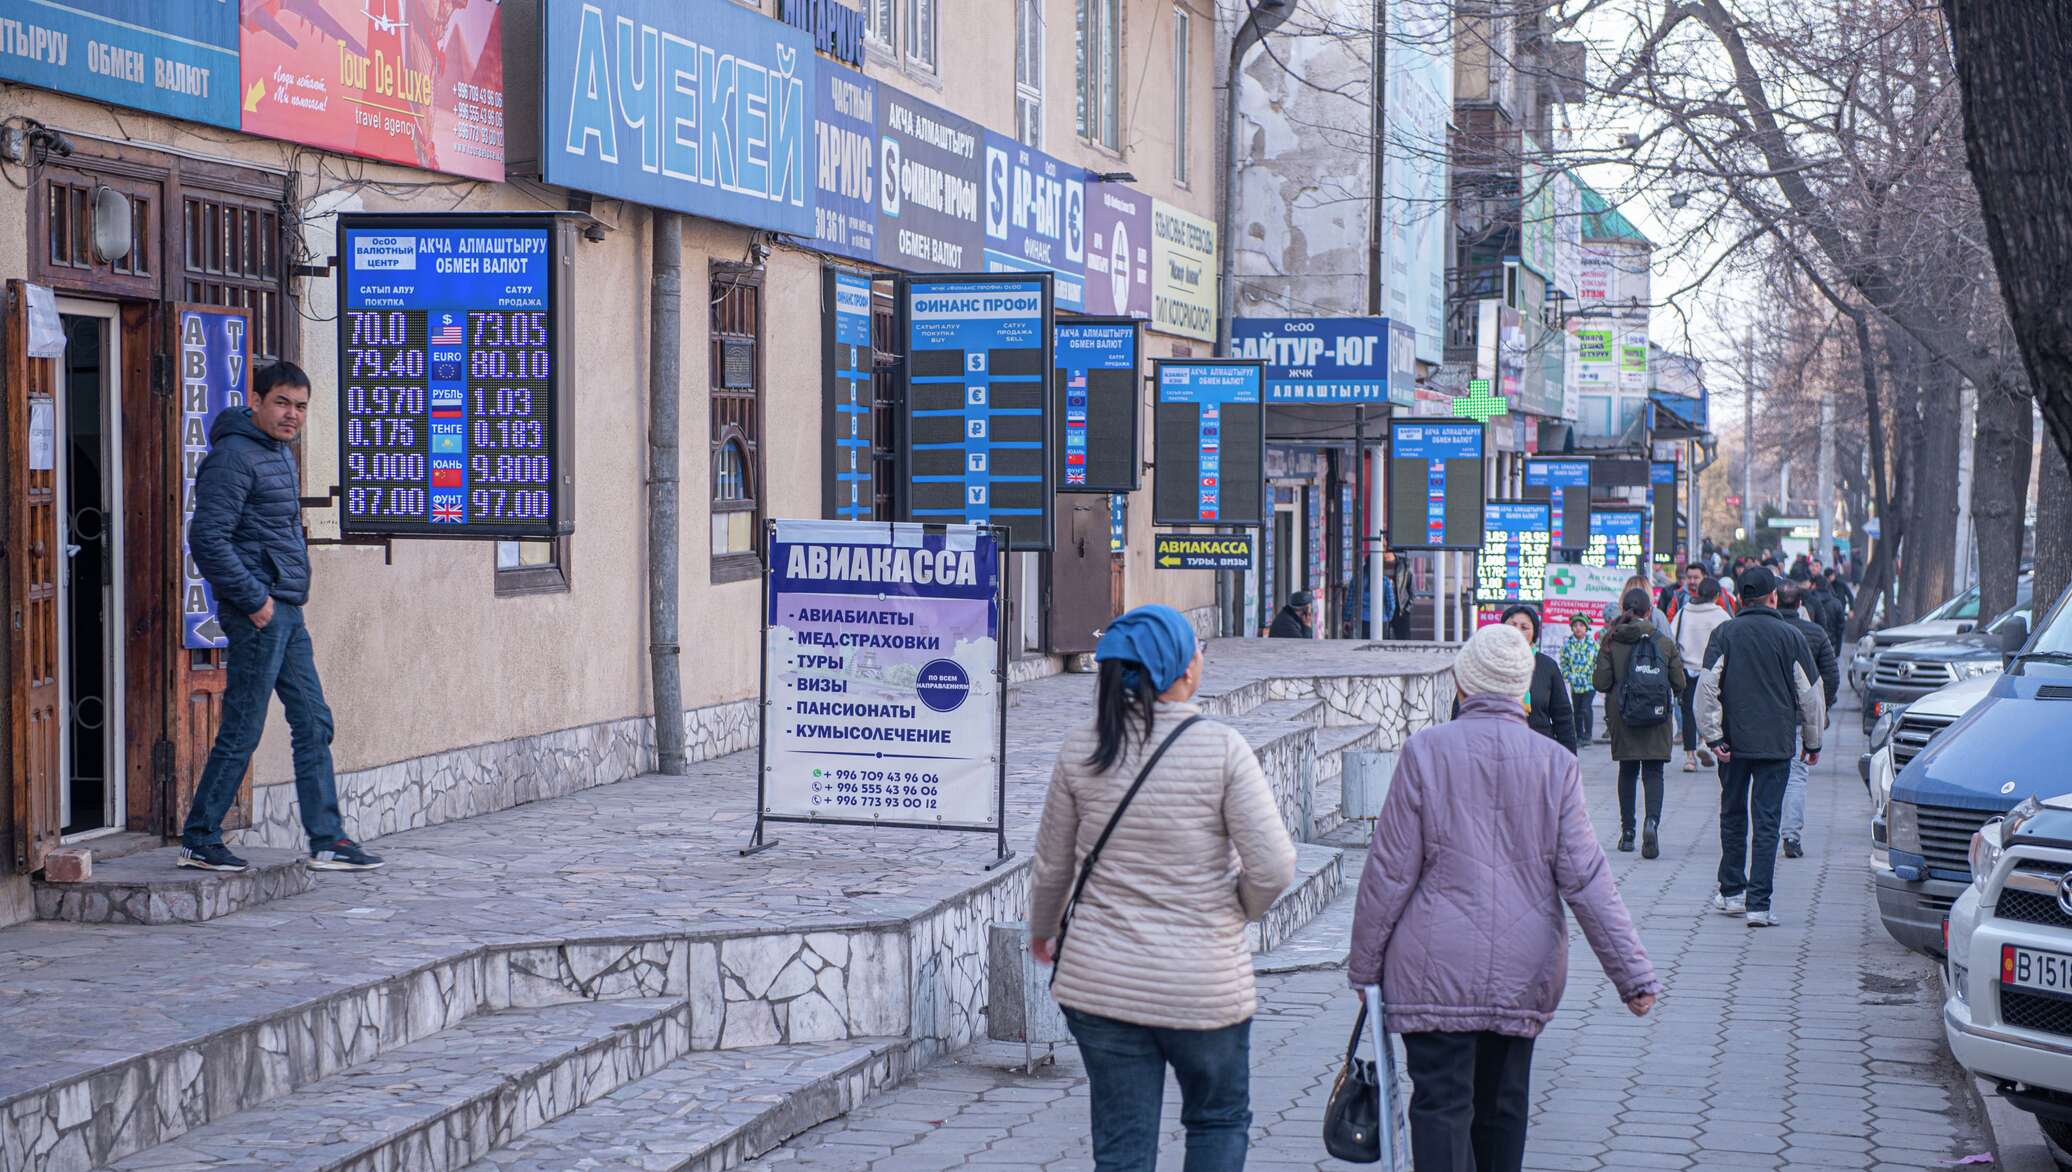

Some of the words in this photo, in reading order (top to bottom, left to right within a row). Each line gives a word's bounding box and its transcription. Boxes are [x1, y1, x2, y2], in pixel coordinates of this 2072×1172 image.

[0, 17, 68, 66] ТЫРУУ
[87, 40, 145, 84] ОБМЕН
[155, 57, 210, 98] ВАЛЮТ
[337, 39, 371, 90] Tour
[375, 49, 393, 97] De
[397, 55, 434, 106] Luxe
[566, 3, 804, 207] АЧЕКЕЙ
[832, 76, 872, 124] ЧАСТНЫЙ
[355, 109, 382, 129] travel
[384, 116, 417, 140] agency
[889, 102, 914, 136] АКЧА
[915, 115, 975, 159] АЛМАШТЫРУУ
[901, 158, 943, 213] ФИНАНС
[944, 173, 977, 222] ПРОФИ
[1012, 165, 1062, 240] АР-БАТ
[826, 209, 837, 243] 36
[838, 213, 845, 245] 11
[356, 246, 414, 255] ВАЛЮТНЫЙ
[372, 238, 397, 246] ОсОО
[418, 237, 452, 254] АКЧА
[458, 238, 548, 255] АЛМАШТЫРУУ
[898, 228, 930, 261] ОБМЕН
[932, 238, 963, 269] ВАЛЮТ
[1024, 236, 1052, 264] ФИНАНС
[367, 259, 400, 268] ЦЕНТР
[435, 257, 480, 274] ОБМЕН
[482, 258, 529, 274] ВАЛЮТ
[360, 285, 391, 294] САТЫП
[392, 286, 415, 295] АЛУУ
[505, 286, 533, 294] САТУУ
[364, 298, 405, 306] ПОКУПКА
[498, 298, 542, 306] ПРОДАЖА
[914, 299, 980, 313] ФИНАНС
[983, 297, 1038, 312] ПРОФИ
[347, 312, 407, 345] 70.0
[442, 313, 453, 326] $
[1284, 322, 1315, 332] ОсОО
[469, 313, 547, 346] 73.05
[996, 329, 1033, 337] ПРОДАЖА
[1060, 328, 1079, 338] АКЧА
[1082, 328, 1134, 338] АЛМАШТЫРУУ
[1070, 339, 1095, 349] ОБМЕН
[1096, 339, 1123, 349] ВАЛЮТ
[347, 350, 425, 377] 79.40
[433, 352, 462, 362] EURO
[471, 351, 549, 378] 80.10
[1190, 367, 1207, 376] АКЧА
[1288, 368, 1313, 378] ЖЧК
[347, 386, 424, 414] 0.970
[432, 390, 463, 399] РУБЛЬ
[1273, 384, 1380, 398] АЛМАШТЫРУУ
[473, 388, 532, 416] 1.03
[348, 418, 415, 446] 0.175
[432, 424, 463, 434] ТЕНГЕ
[474, 420, 543, 448] 0.183
[348, 453, 424, 480] 9.000
[432, 460, 462, 469] ЮАНЬ
[472, 455, 549, 482] 9.800
[348, 488, 425, 515] 87.00
[432, 495, 463, 504] ФУНТ
[472, 490, 549, 517] 97.00
[1158, 540, 1250, 555] АВИАКАССА
[786, 545, 977, 585] АВИАКАССА
[1219, 557, 1249, 567] ВИЗЫ
[798, 607, 914, 626] АВИАБИЛЕТЫ
[797, 631, 940, 650] МЕД.СТРАХОВКИ
[796, 655, 844, 670] ТУРЫ
[796, 678, 847, 693] ВИЗЫ
[796, 701, 916, 719] ПАНСИОНАТЫ
[796, 724, 952, 744] КУМЫСОЛЕЧЕНИЕ
[836, 769, 857, 780] 996
[860, 771, 884, 781] 709
[887, 772, 901, 782] 43
[904, 773, 918, 783] 96
[922, 773, 939, 783] 06
[837, 782, 858, 793] 996
[861, 783, 882, 794] 555
[885, 785, 899, 795] 43
[903, 785, 917, 796] 96
[920, 786, 938, 796] 06
[836, 795, 858, 806] 996
[861, 796, 882, 807] 773
[885, 797, 899, 807] 93
[902, 798, 922, 808] 00
[924, 798, 937, 809] 12
[2018, 951, 2032, 982] B
